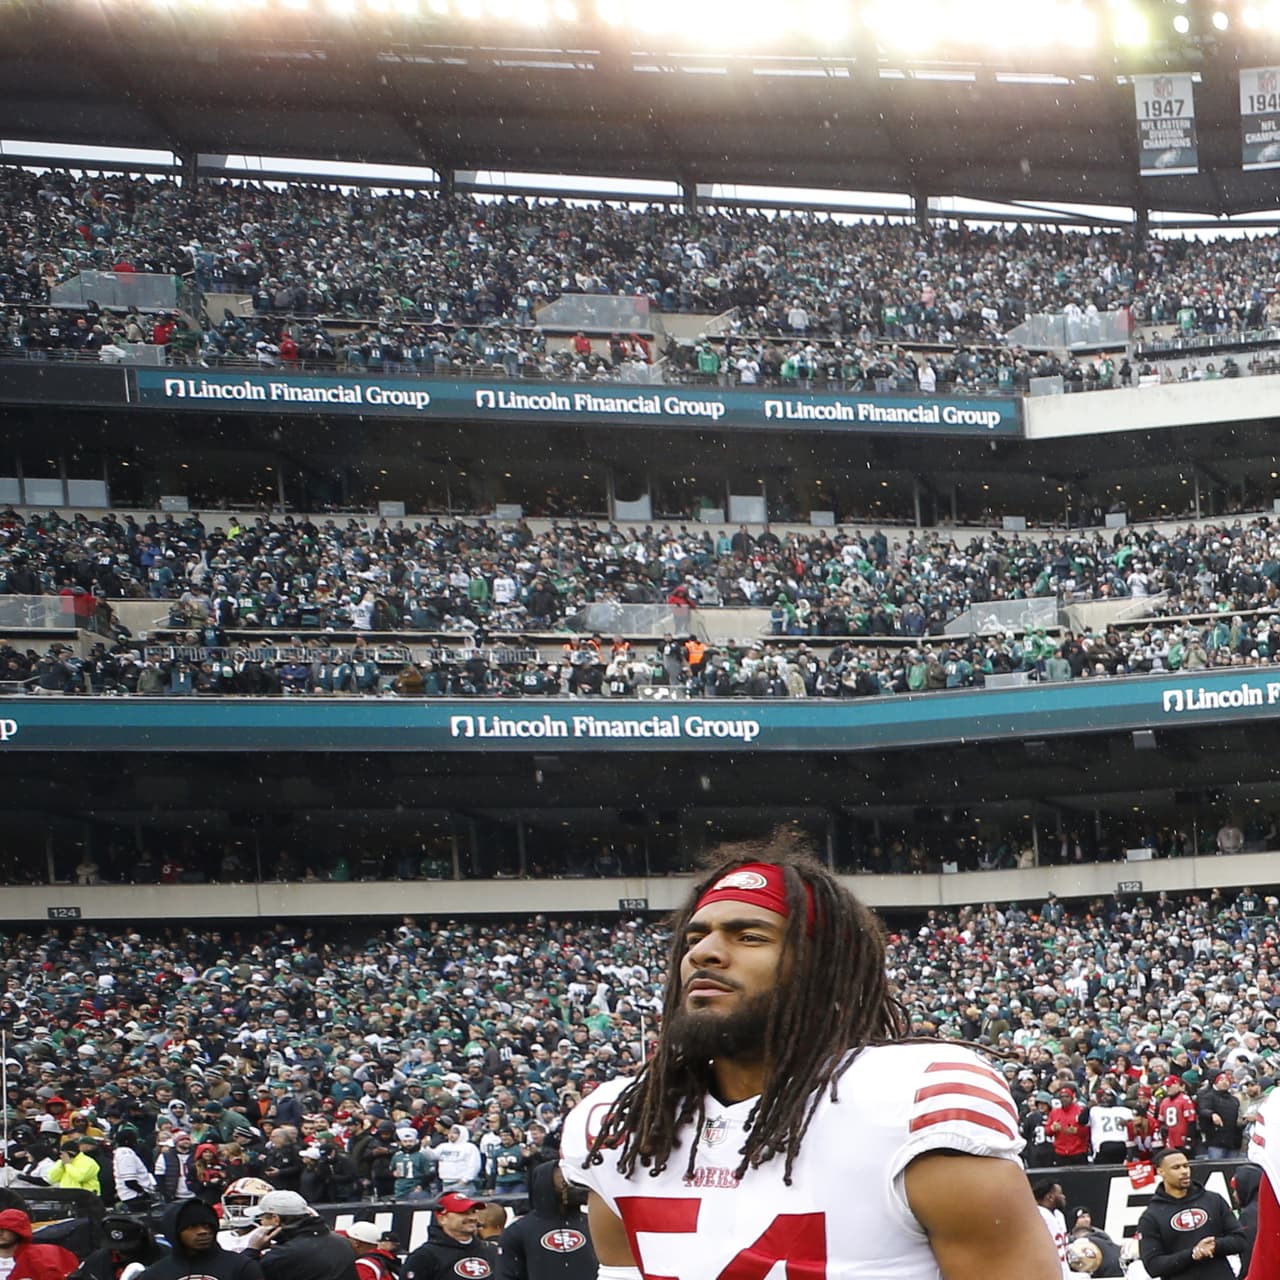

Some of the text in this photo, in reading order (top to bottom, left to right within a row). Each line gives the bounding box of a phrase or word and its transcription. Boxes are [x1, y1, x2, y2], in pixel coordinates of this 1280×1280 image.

[1144, 100, 1184, 117] 1947
[1261, 120, 1277, 131] NFL
[1143, 137, 1192, 149] CHAMPIONS
[188, 380, 430, 409] Lincoln Financial Group
[498, 391, 725, 420] Lincoln Financial Group
[785, 401, 1001, 428] Lincoln Financial Group
[1184, 684, 1262, 711] Lincoln
[478, 715, 759, 742] Lincoln Financial Group
[1120, 882, 1140, 892] 122
[51, 908, 77, 918] 124
[623, 900, 646, 909] 123
[1164, 1106, 1178, 1127] 8
